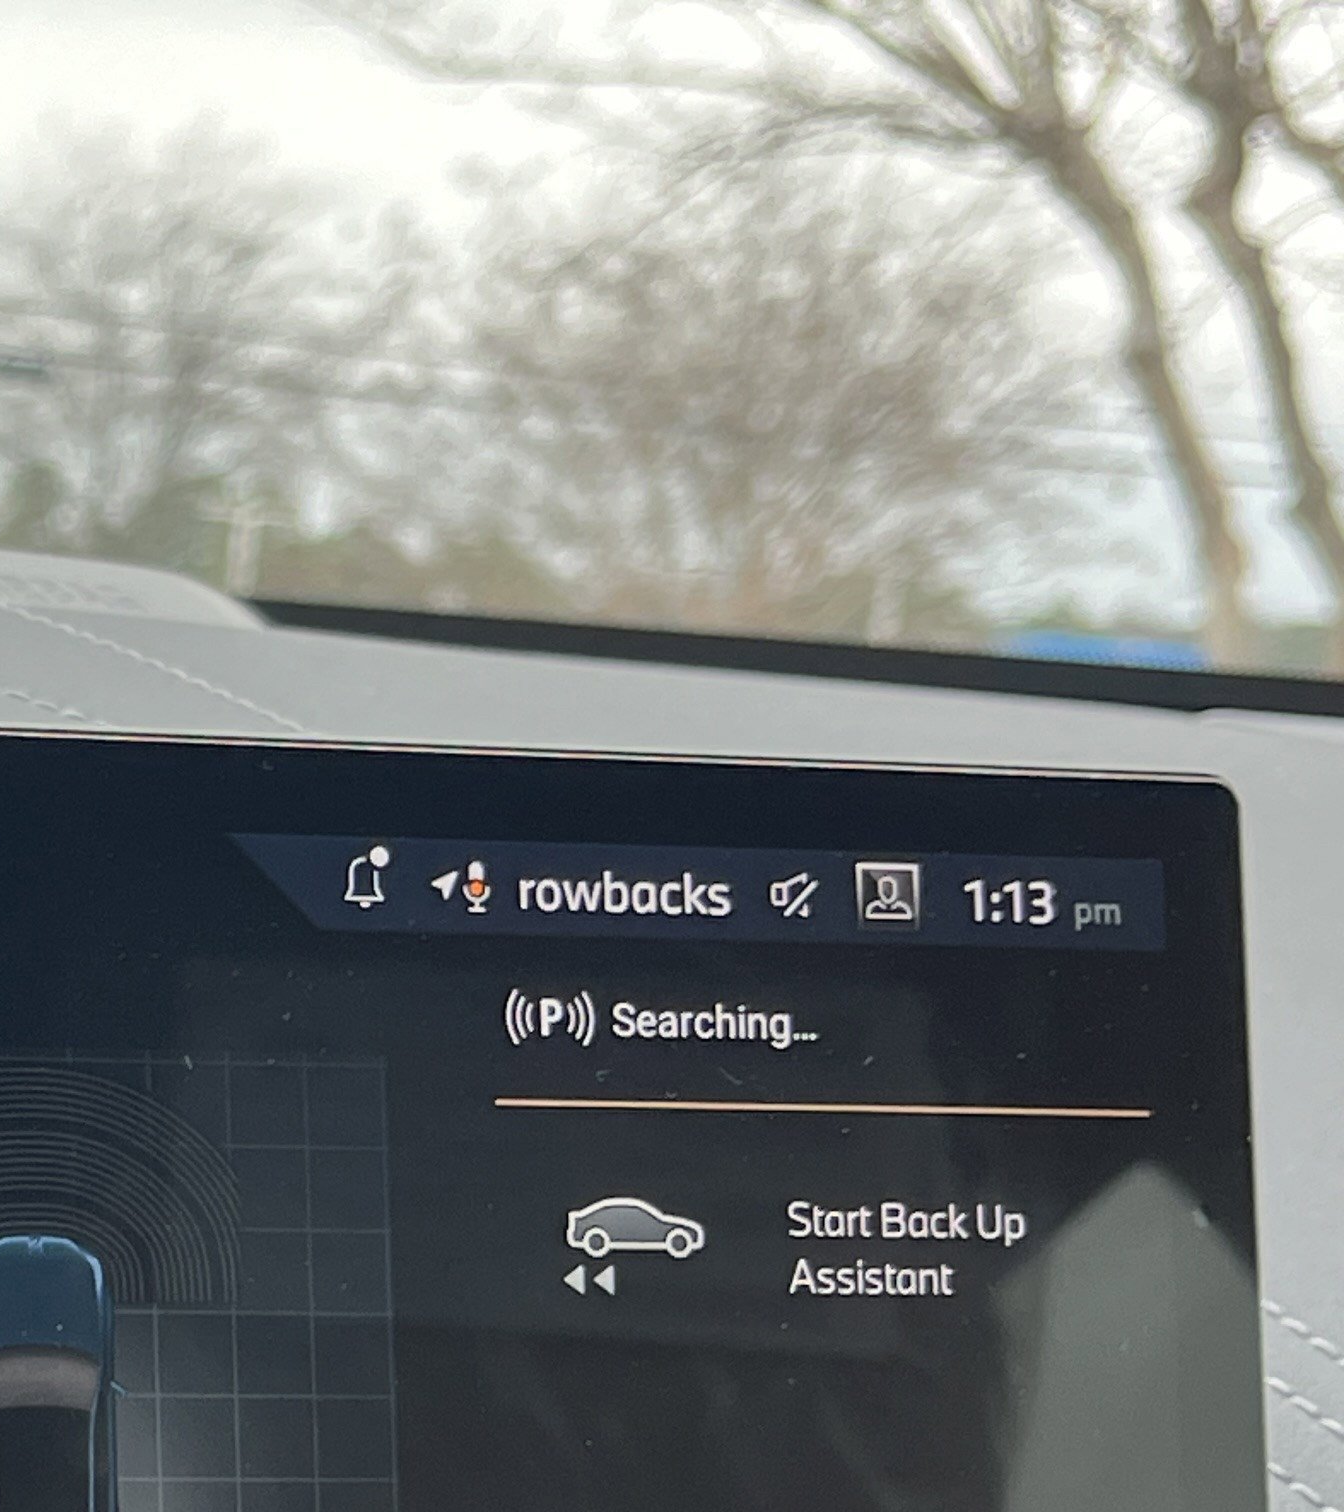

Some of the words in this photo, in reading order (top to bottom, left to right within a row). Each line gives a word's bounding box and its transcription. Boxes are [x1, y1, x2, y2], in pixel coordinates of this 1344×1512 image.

[519, 870, 732, 917] rowbacks
[964, 879, 1056, 925] 1:13
[1074, 902, 1122, 931] pm
[787, 1200, 873, 1238] Start
[880, 1202, 969, 1239] Back
[976, 1204, 1026, 1247] Up
[789, 1258, 954, 1296] Assistant
